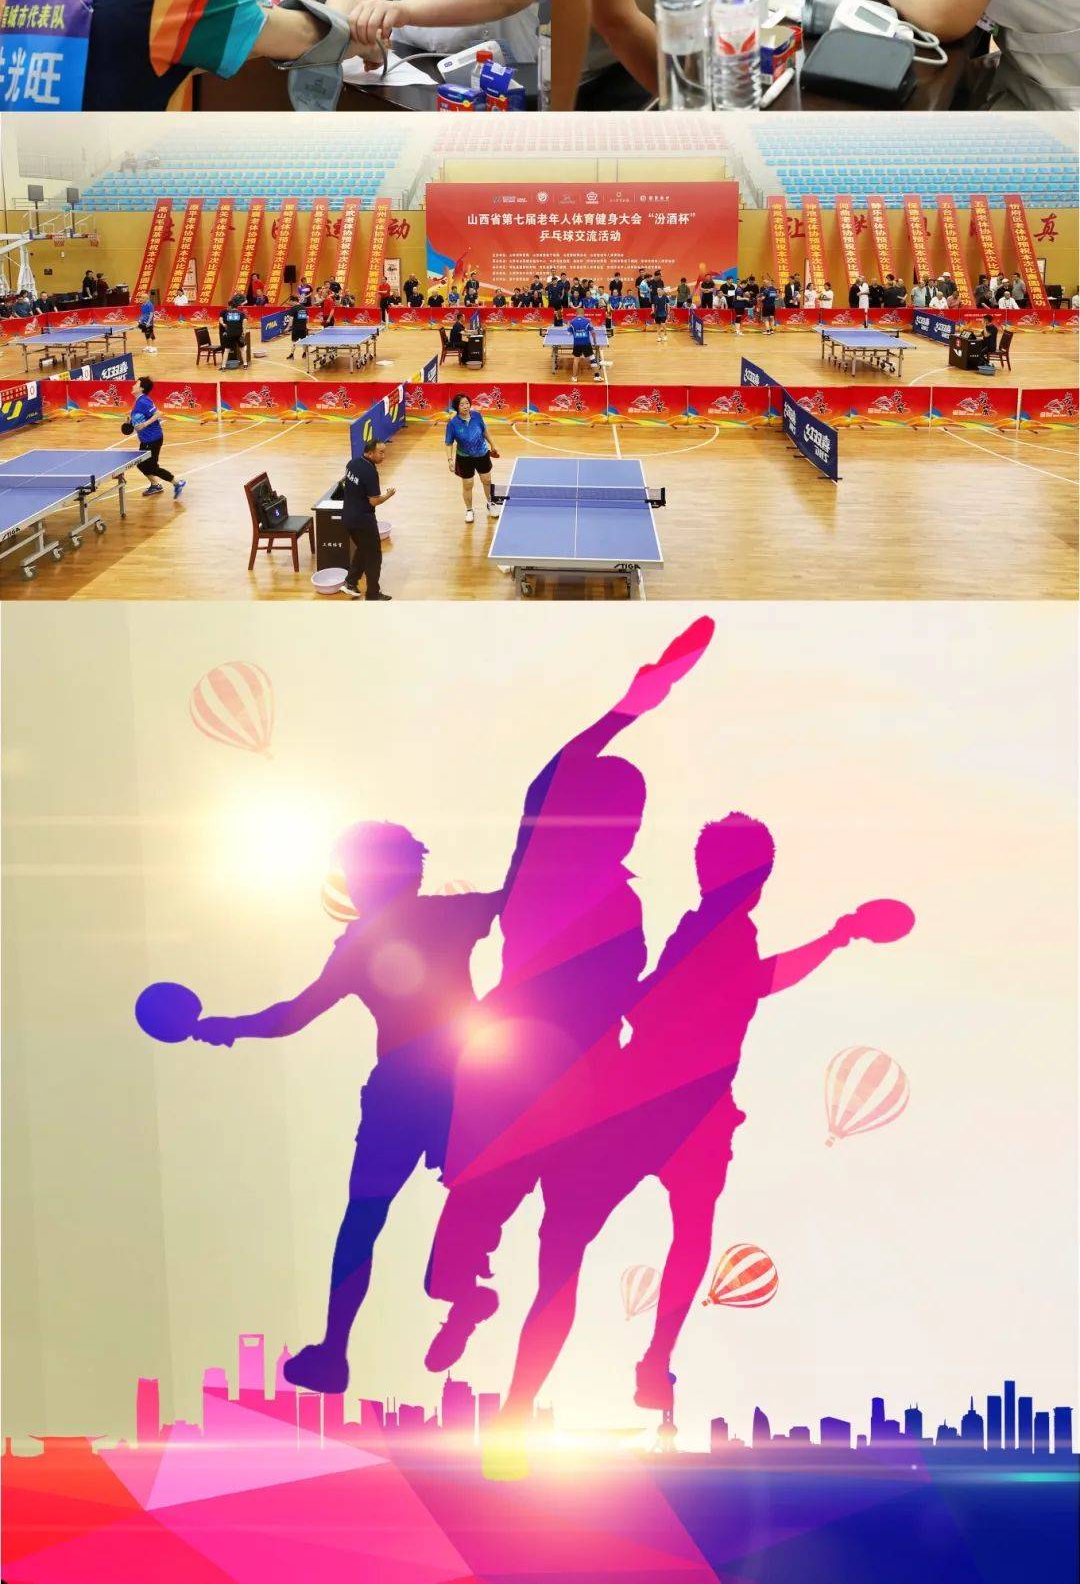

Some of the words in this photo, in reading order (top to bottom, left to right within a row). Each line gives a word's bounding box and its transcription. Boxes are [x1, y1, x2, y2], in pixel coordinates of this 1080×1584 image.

[540, 230, 621, 243] 乒乓球交流活动
[613, 562, 642, 570] STIGA
